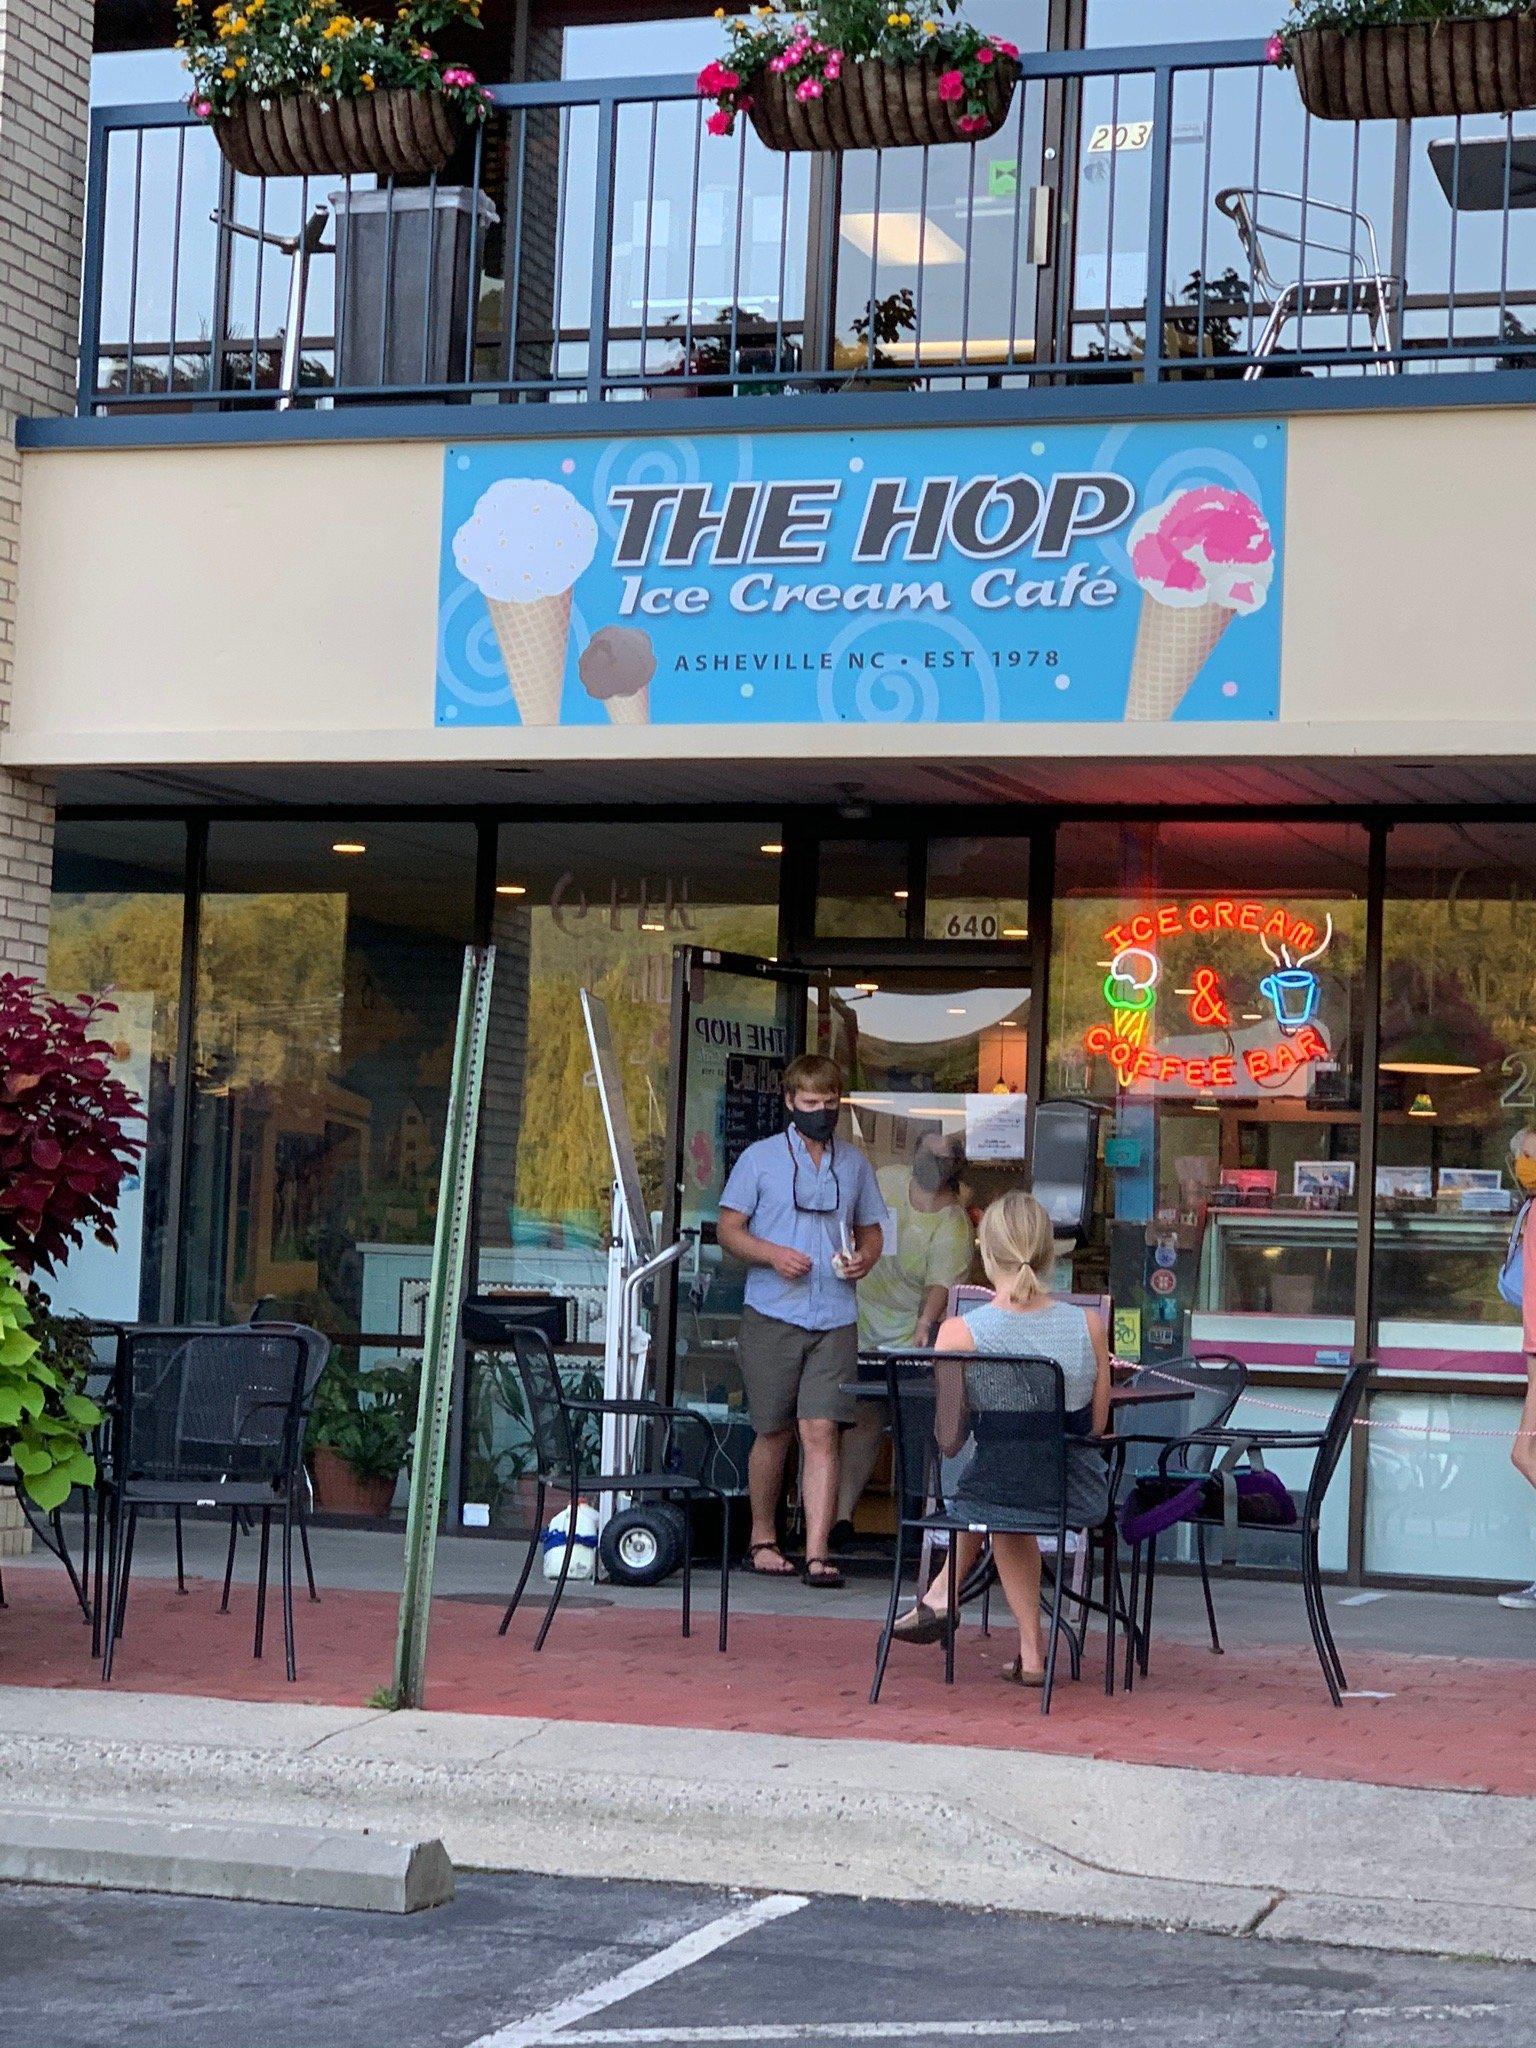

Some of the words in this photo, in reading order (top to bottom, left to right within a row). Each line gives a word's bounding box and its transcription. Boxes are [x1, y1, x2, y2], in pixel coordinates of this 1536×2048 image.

[1091, 124, 1147, 150] 203
[606, 478, 843, 567] THE
[852, 472, 1135, 563] HOP
[618, 575, 708, 615] Ice
[729, 571, 951, 613] Cream
[970, 562, 1118, 609] Café
[674, 652, 833, 672] ASHEVILLE
[848, 651, 886, 670] NC
[925, 650, 975, 669] EST
[993, 649, 1060, 668] 1978
[947, 914, 996, 937] 640
[1103, 905, 1183, 953] ICE
[1187, 901, 1317, 950] CREAM
[1191, 968, 1228, 1024] &
[1086, 1027, 1236, 1085] COFFEE
[1247, 1029, 1327, 1078] BAR
